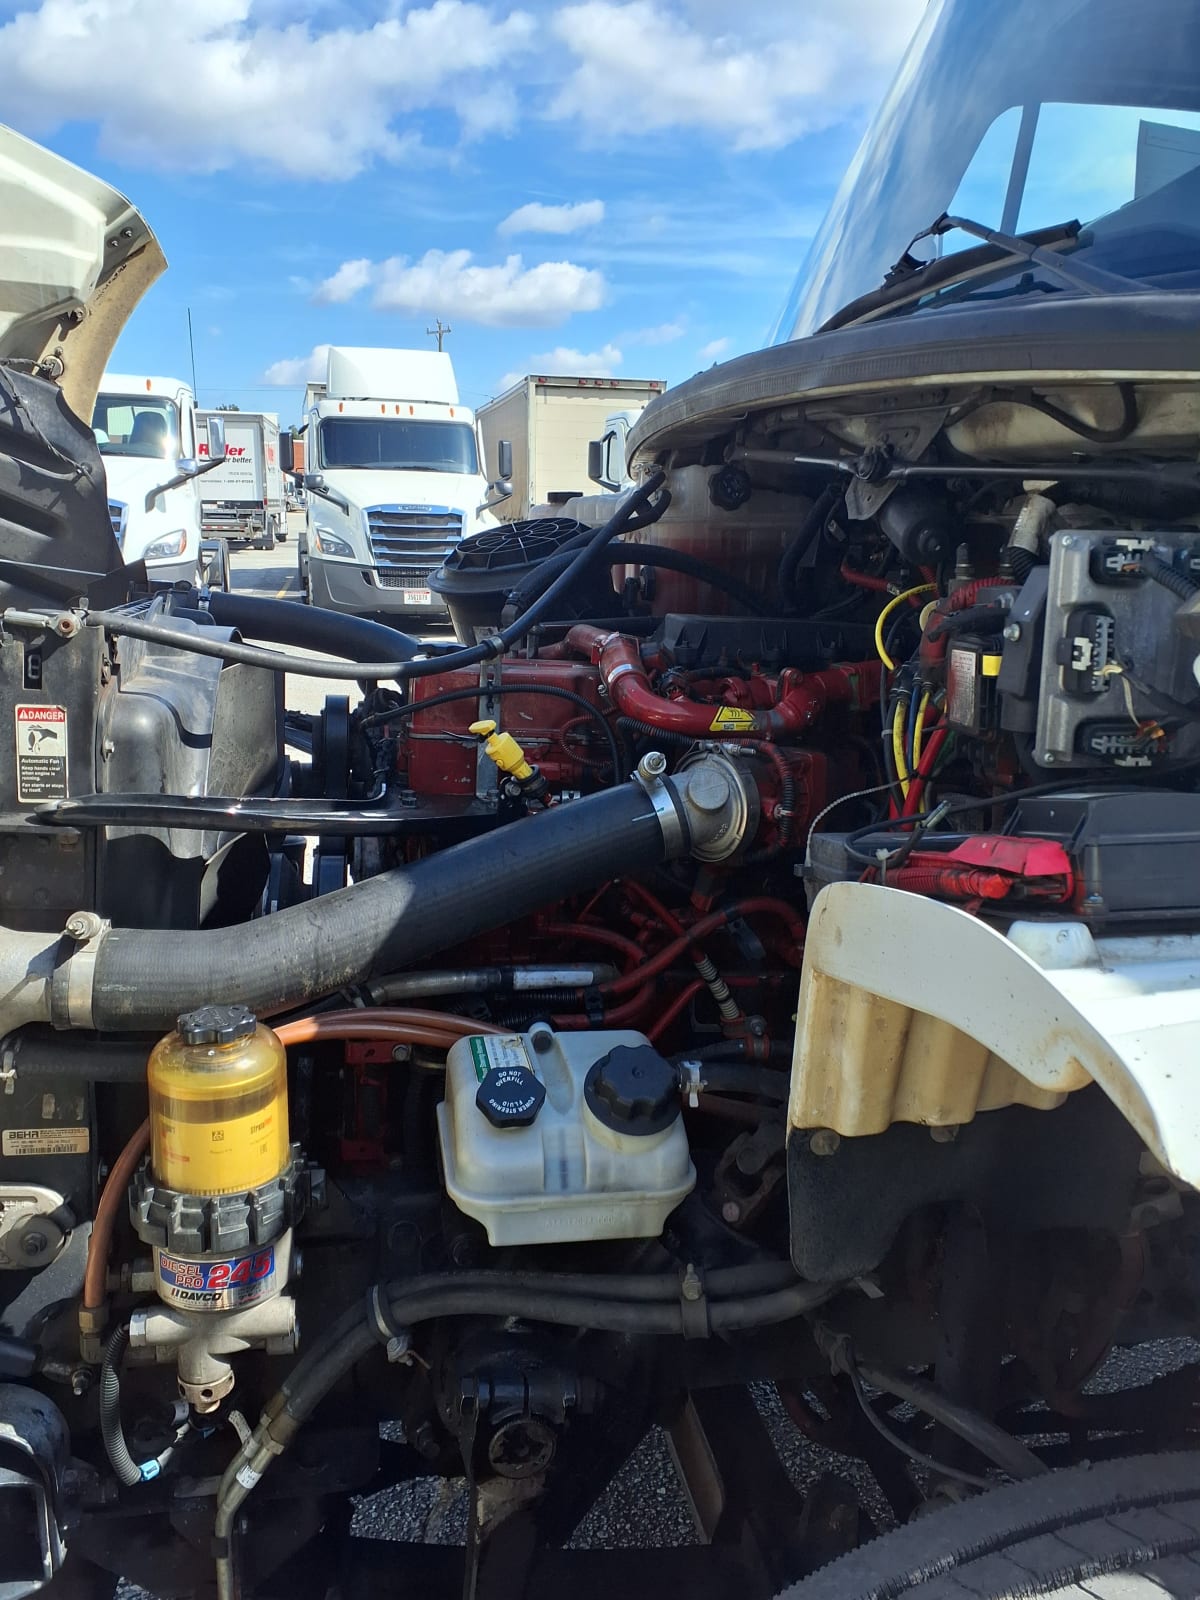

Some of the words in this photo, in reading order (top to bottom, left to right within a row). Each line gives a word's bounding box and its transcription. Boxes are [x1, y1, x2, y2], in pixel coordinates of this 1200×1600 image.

[198, 443, 246, 456] Rer
[28, 711, 65, 720] DANGER
[495, 1076, 524, 1087] OVERFILL
[488, 1098, 517, 1114] STEERING
[502, 1099, 523, 1107] FLUID
[518, 1096, 536, 1112] POWER
[9, 1131, 39, 1139] BEHR
[160, 1255, 203, 1277] DIESEL
[206, 1250, 272, 1289] 245
[175, 1273, 204, 1289] PRO
[179, 1289, 223, 1302] DAVCO
